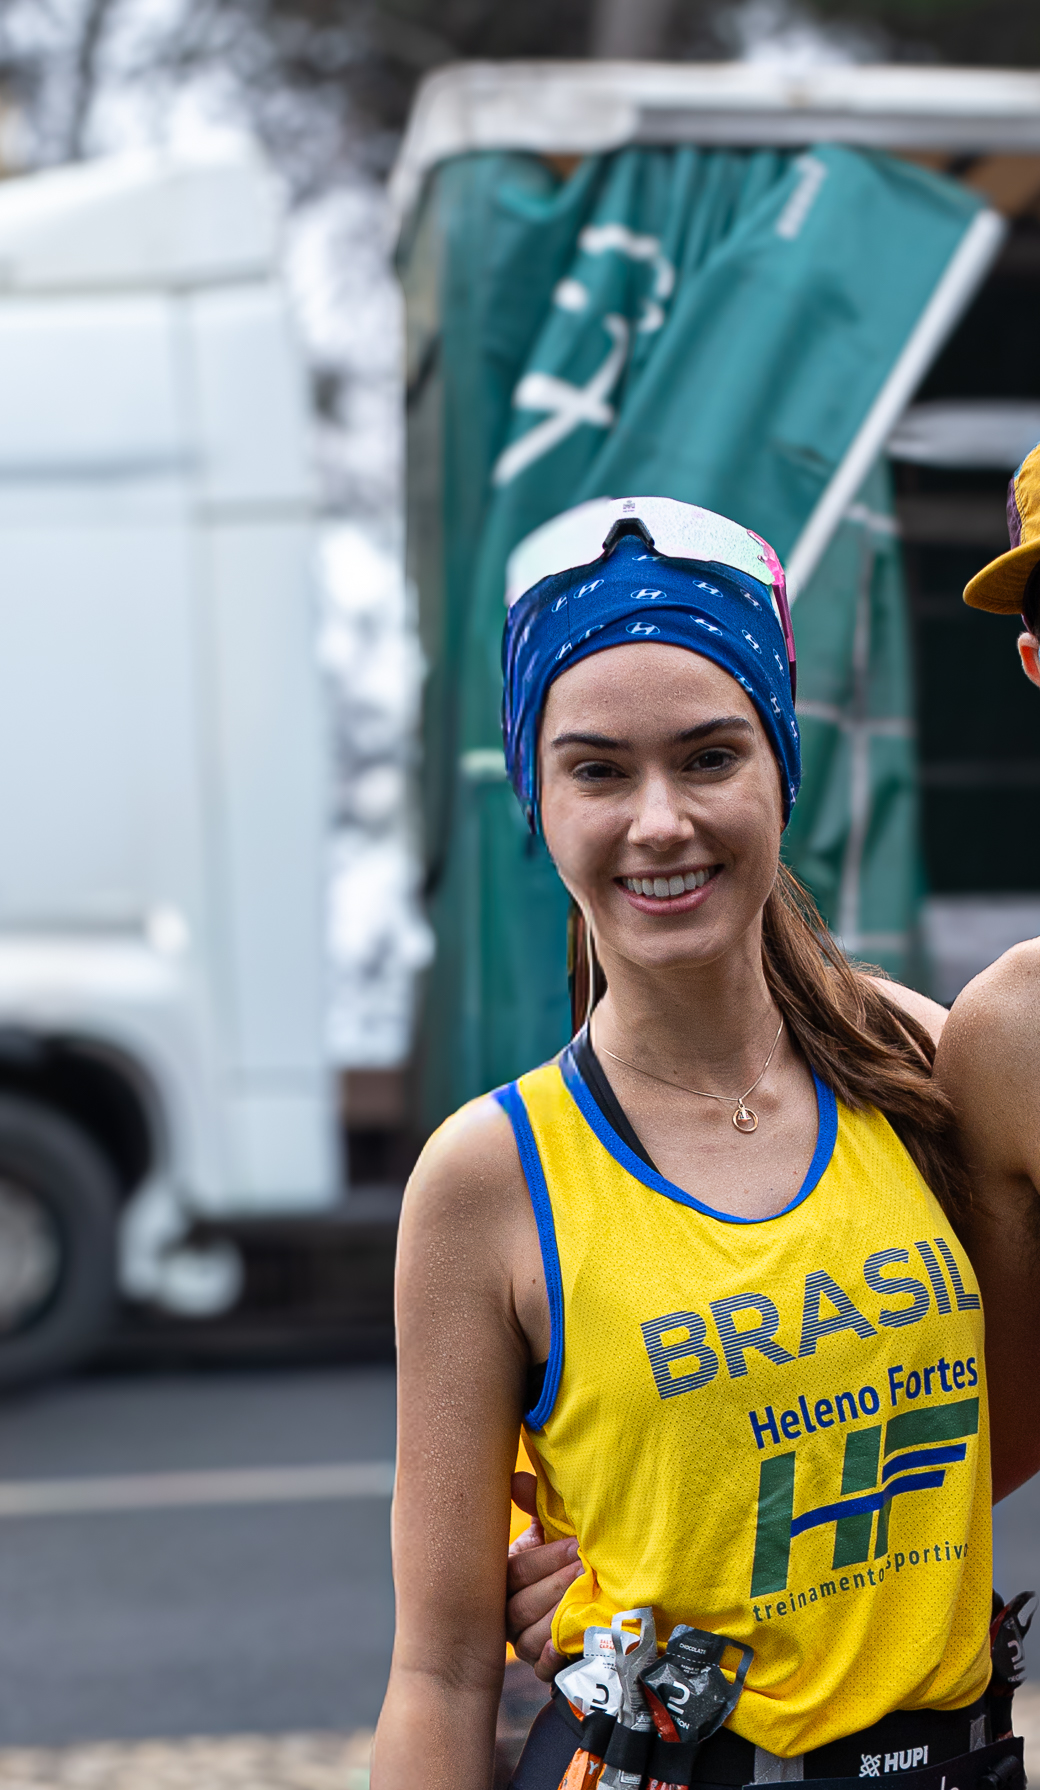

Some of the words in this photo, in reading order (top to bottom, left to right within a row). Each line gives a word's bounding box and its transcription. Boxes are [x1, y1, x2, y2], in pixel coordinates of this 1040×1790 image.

[640, 1238, 981, 1400] BRASIL
[748, 1384, 880, 1450] Heleno
[888, 1356, 979, 1407] Fortes
[753, 1567, 885, 1622] treinamento
[884, 1745, 929, 1773] HUPI
